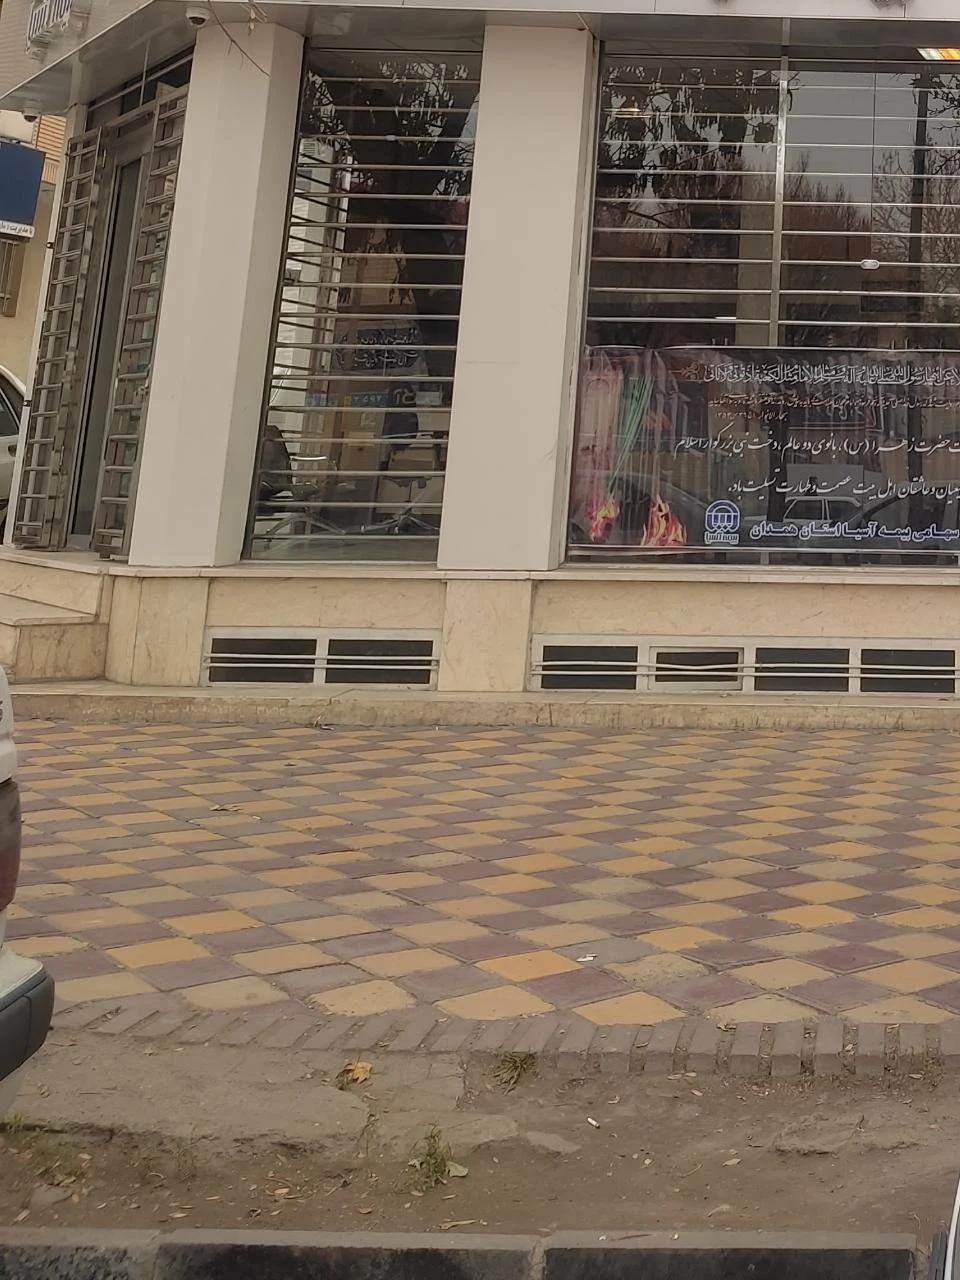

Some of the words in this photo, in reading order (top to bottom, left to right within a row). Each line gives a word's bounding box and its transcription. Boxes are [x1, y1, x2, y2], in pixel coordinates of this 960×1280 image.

[673, 437, 703, 461] اسلام
[810, 432, 838, 459] بانوی
[872, 437, 916, 455] زهرا
[914, 434, 951, 456] حضرت
[743, 468, 781, 500] تسلیت
[775, 481, 810, 494] طهارت
[816, 475, 853, 493] عصمت
[852, 481, 876, 500] بیت
[877, 476, 896, 499] اهل
[750, 520, 799, 540] همدان
[800, 521, 841, 540] استان
[841, 521, 877, 540] آسیا
[877, 525, 912, 542] بیمه
[912, 524, 960, 543] سهامی
